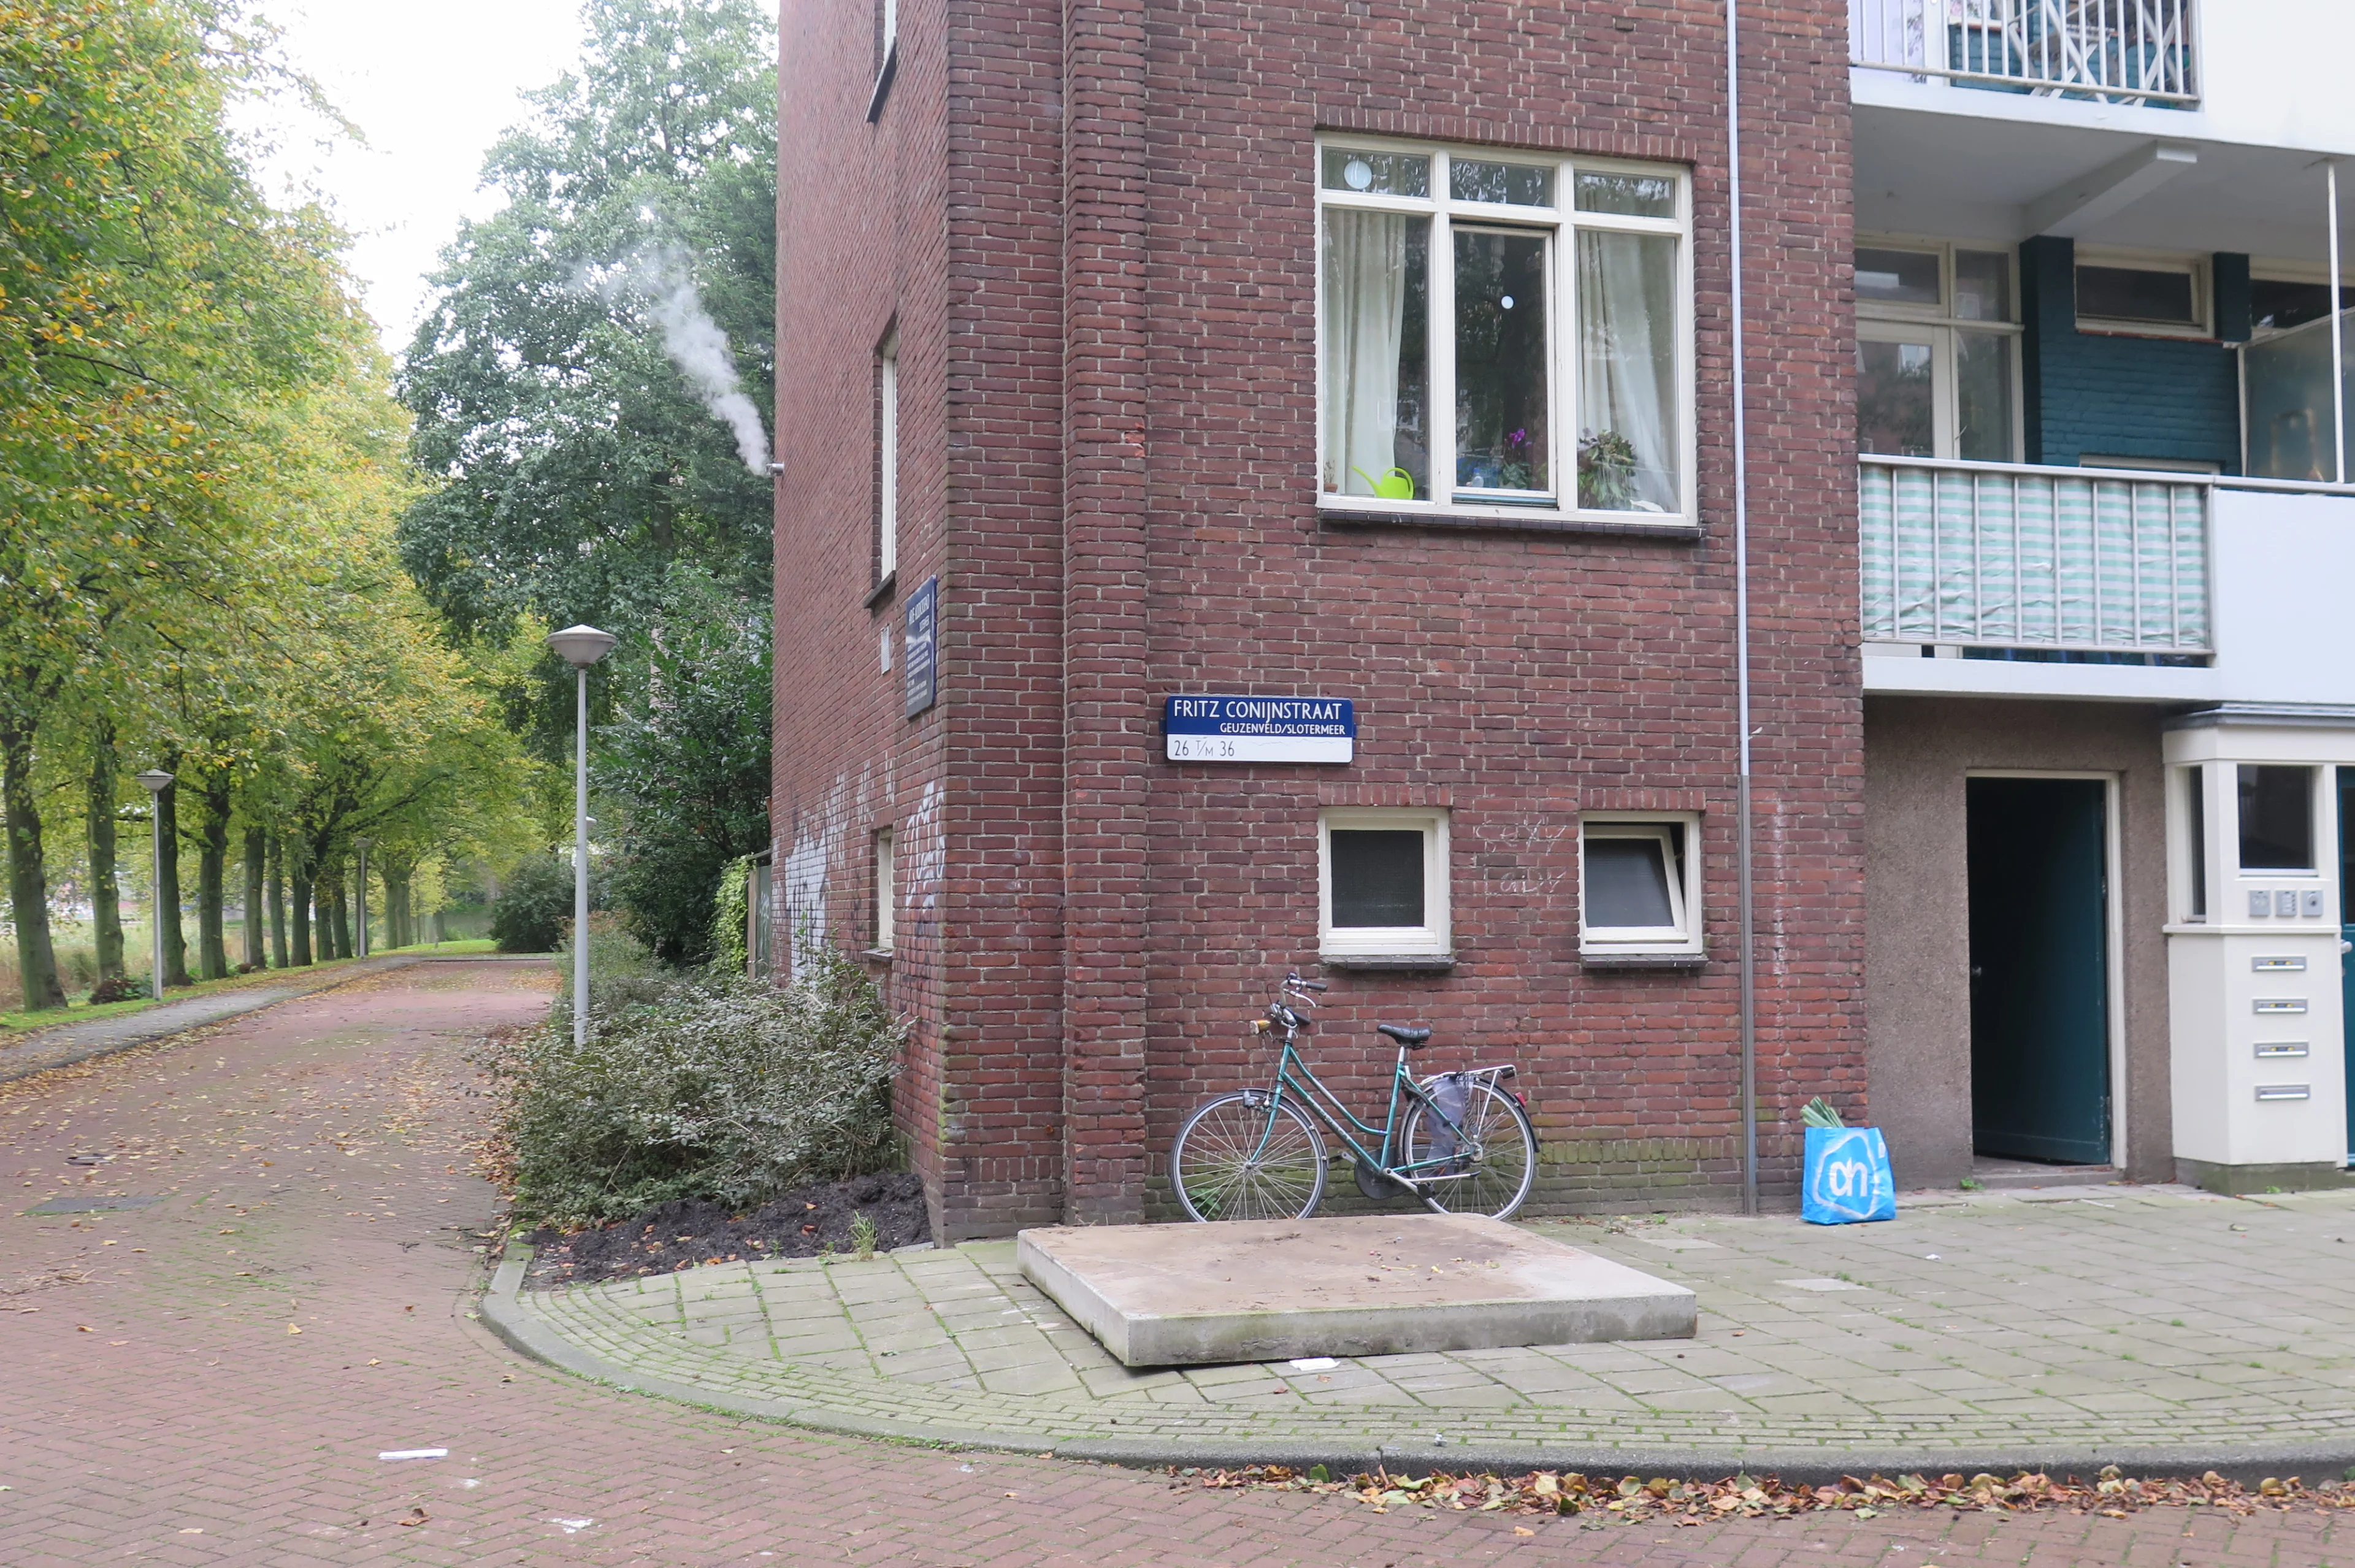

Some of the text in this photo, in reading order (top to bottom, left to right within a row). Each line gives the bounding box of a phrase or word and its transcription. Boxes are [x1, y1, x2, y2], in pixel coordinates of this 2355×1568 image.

[1174, 700, 1342, 723] FRITZ CONIJNSTRAAT
[1220, 722, 1346, 735] GEUZENVELD/SLOTERMEER
[1174, 740, 1189, 756] 26
[1219, 740, 1235, 757] 36
